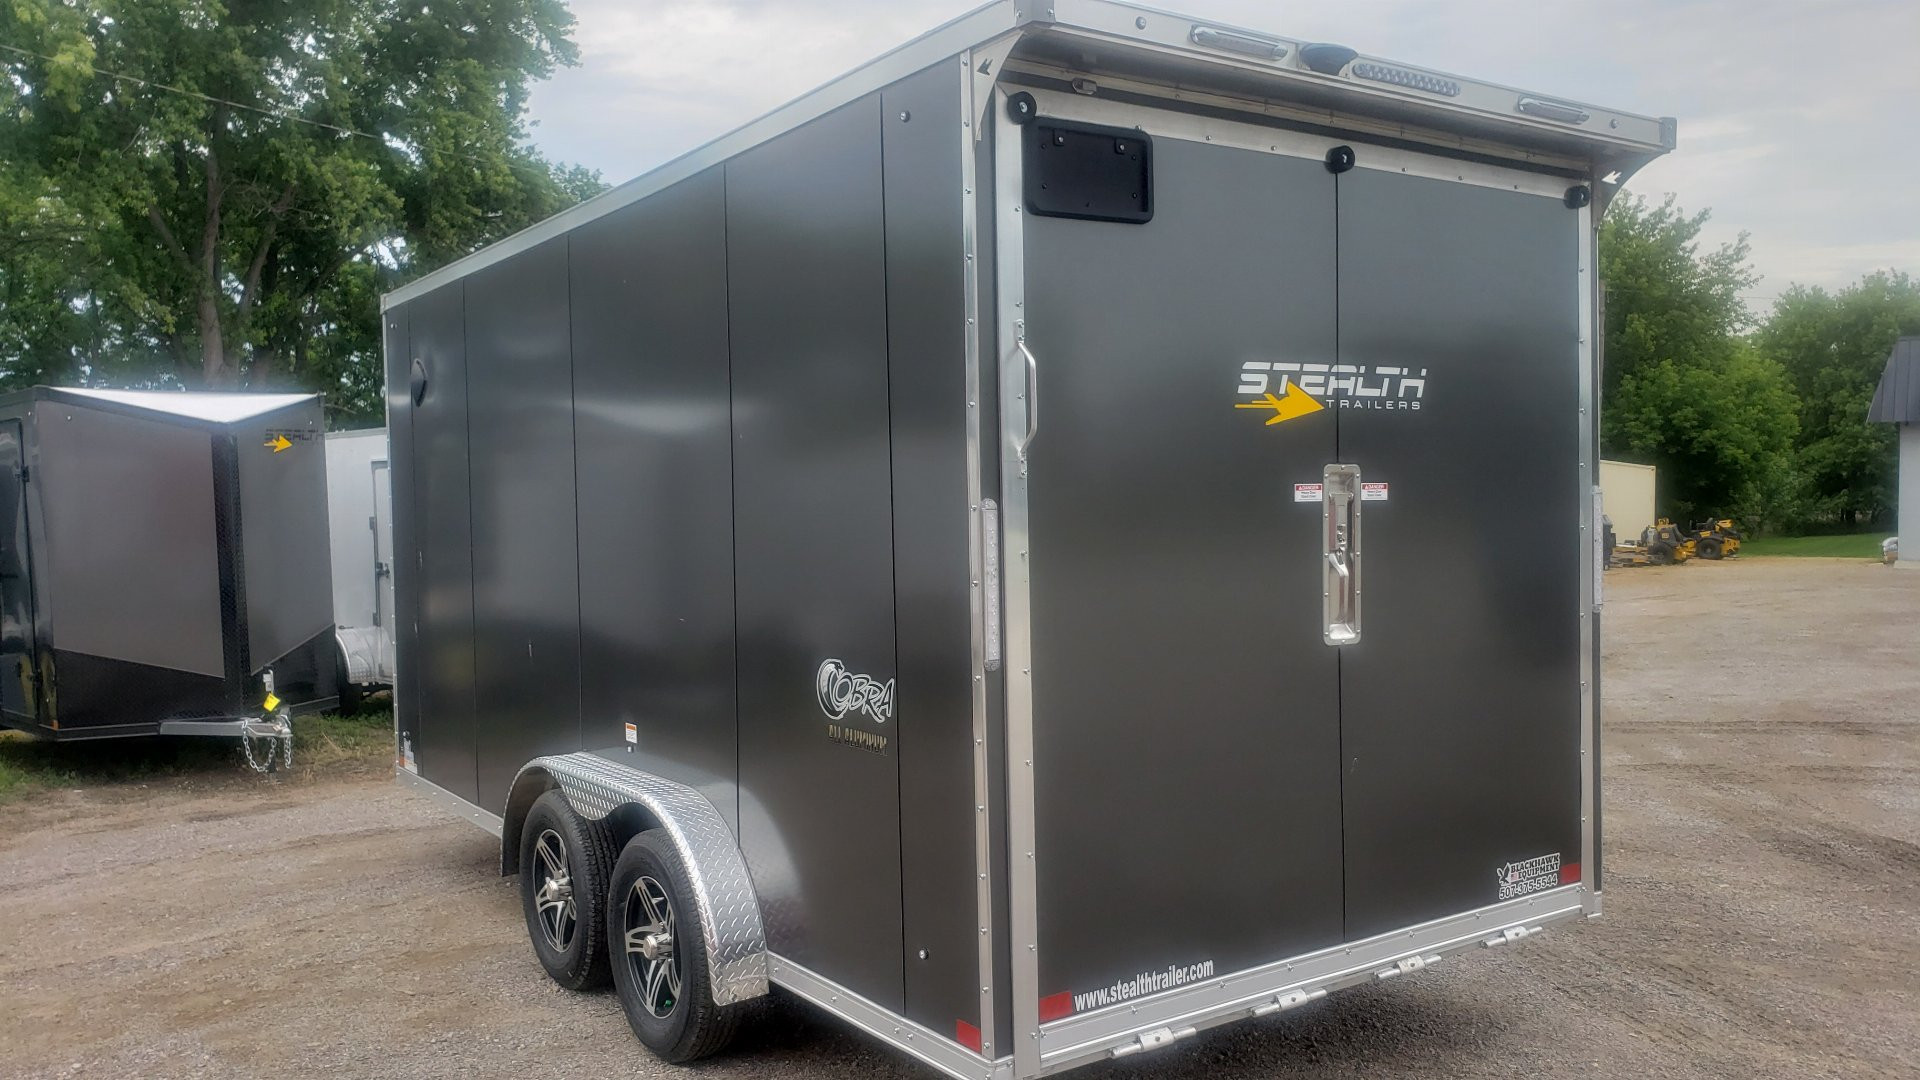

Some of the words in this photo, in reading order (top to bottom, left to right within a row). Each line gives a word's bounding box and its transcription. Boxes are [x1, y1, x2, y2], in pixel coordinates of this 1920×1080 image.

[1237, 361, 1427, 398] STEALTH
[1326, 399, 1421, 410] TRAILERS
[1512, 855, 1559, 873] BLACKHAWK
[1518, 863, 1558, 880] EQUIPMENT
[1499, 873, 1557, 899] 507-375-5544
[1074, 959, 1214, 1012] www.stealthtrailer.com
